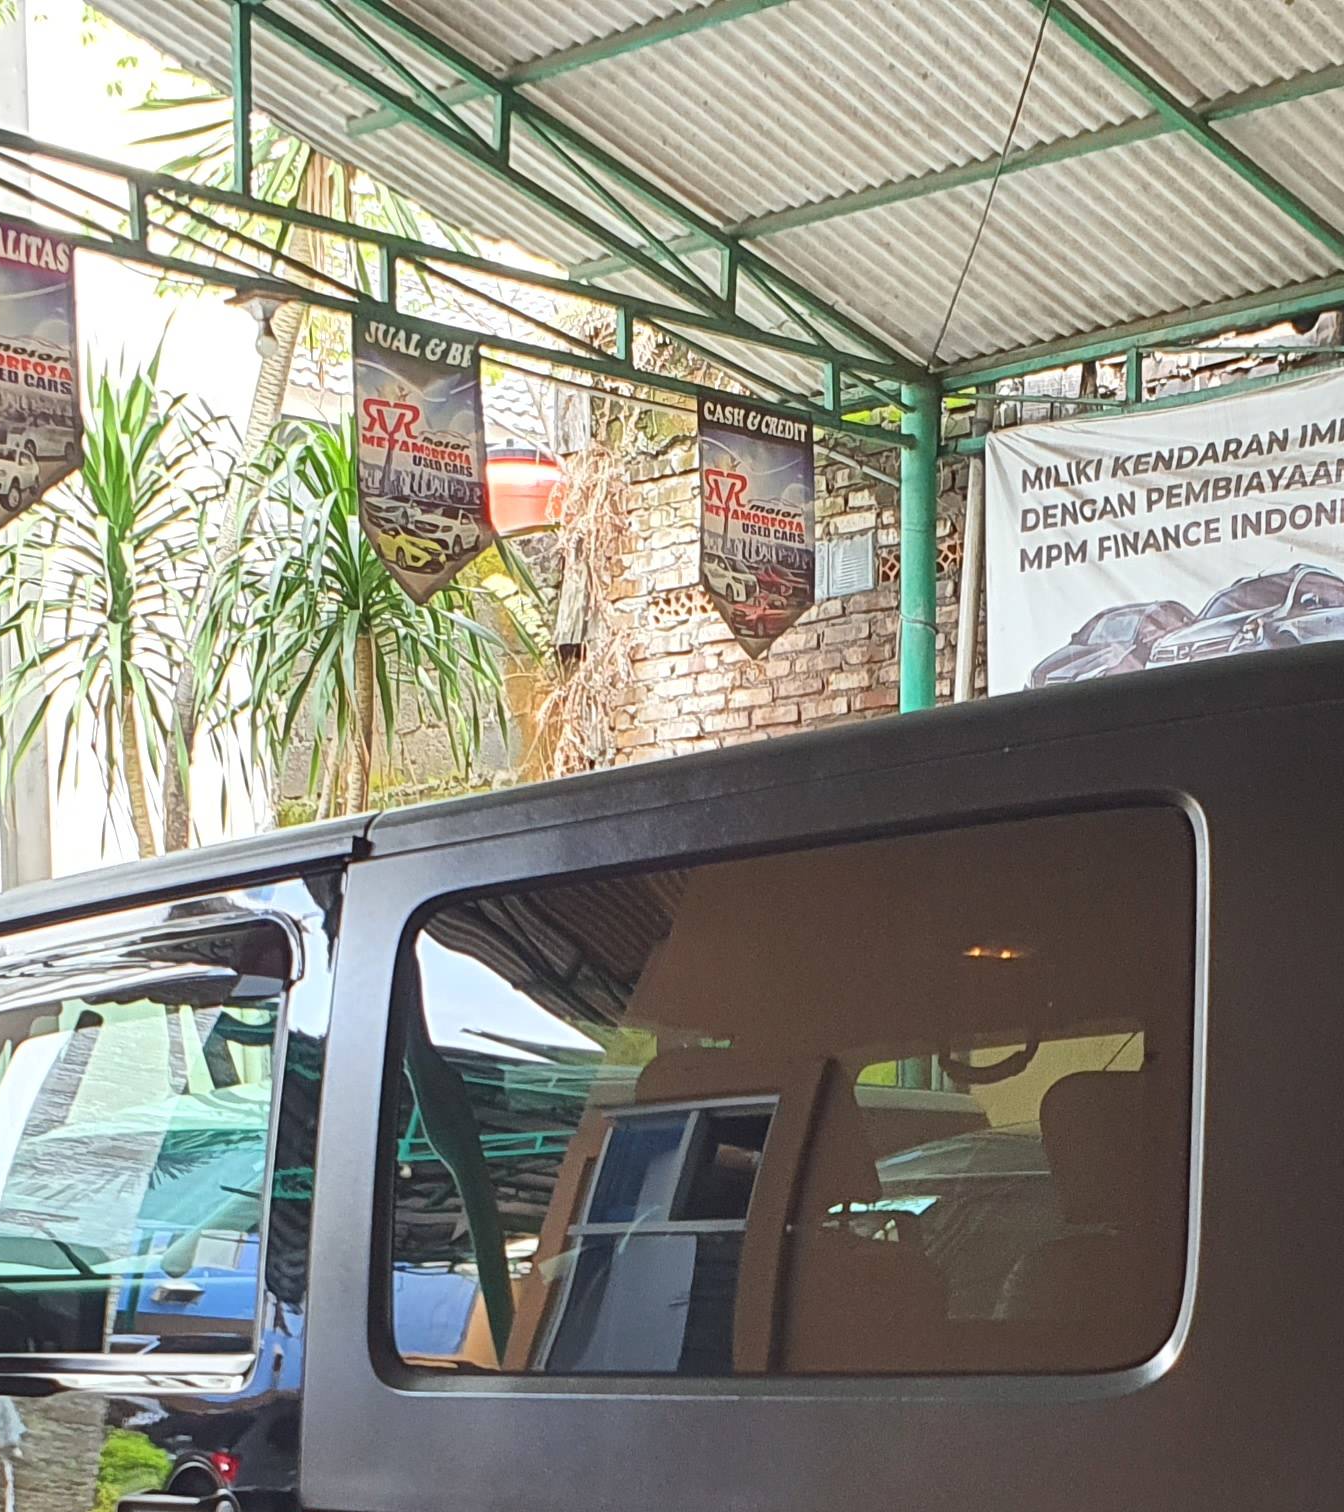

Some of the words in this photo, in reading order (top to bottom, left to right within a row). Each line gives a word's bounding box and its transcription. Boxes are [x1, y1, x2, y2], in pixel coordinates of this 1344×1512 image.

[364, 320, 421, 358] JUAL
[425, 338, 447, 361] &
[23, 373, 73, 395] CARS
[703, 401, 745, 429] CASH
[746, 411, 761, 431] &
[761, 415, 808, 443] CREDIT
[413, 455, 442, 472] USED
[444, 462, 473, 478] CARS
[1020, 458, 1101, 494] MILIKI
[1112, 428, 1290, 481] KENDARAN
[742, 522, 771, 539] USED
[773, 529, 805, 544] CARS
[1020, 492, 1137, 534] DENGAN
[1019, 536, 1087, 573] MPM
[1097, 519, 1221, 563] FINANCE
